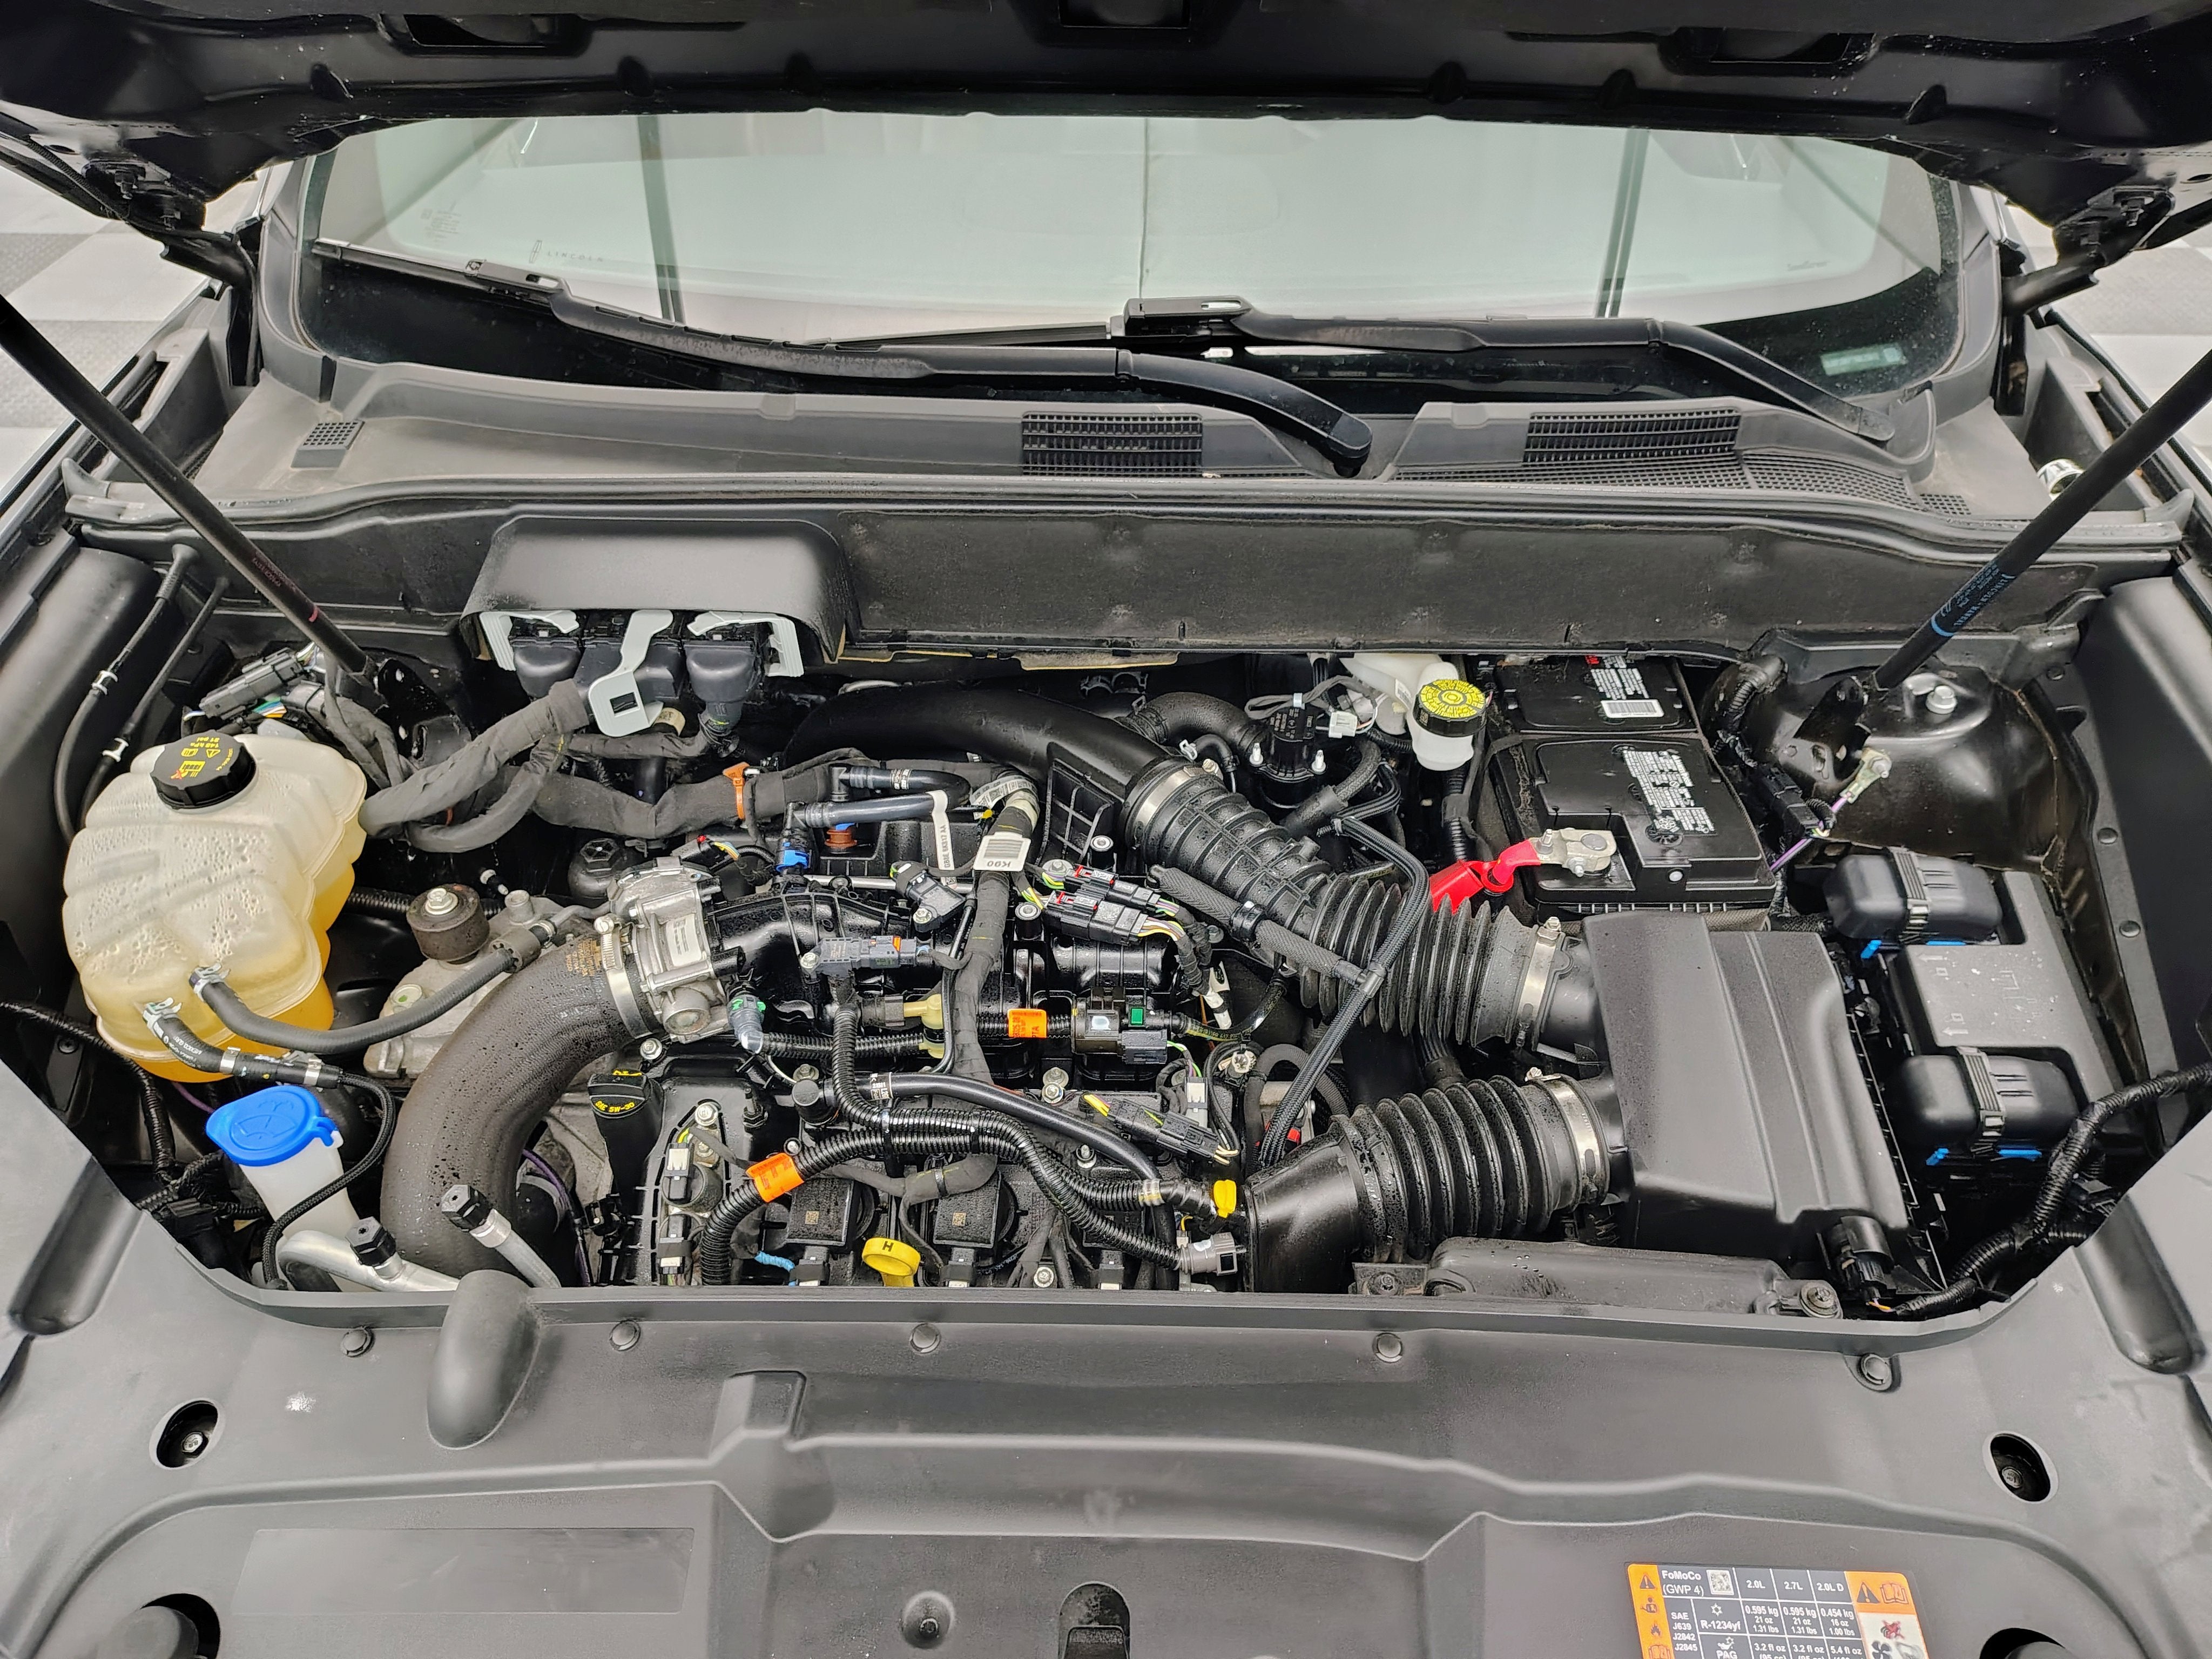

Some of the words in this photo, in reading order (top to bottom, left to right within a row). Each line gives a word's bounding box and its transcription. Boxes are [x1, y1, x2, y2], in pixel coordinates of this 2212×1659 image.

[548, 251, 603, 262] LINCOLN
[595, 1101, 608, 1111] SAE
[609, 1102, 635, 1112] 5W-30
[882, 1240, 894, 1252] H
[1661, 1570, 1701, 1580] FoMoCo
[1746, 1580, 1765, 1589] 2.0L
[1784, 1581, 1803, 1590] 2.7L
[1816, 1582, 1836, 1591] 2.0L
[1836, 1583, 1844, 1591] D
[1663, 1584, 1692, 1595] (GWP
[1694, 1586, 1704, 1597] 4)
[1745, 1605, 1766, 1614] 0.595
[1768, 1606, 1779, 1617] kg
[1783, 1607, 1804, 1616] 0.595
[1806, 1608, 1817, 1618] kg
[1820, 1608, 1842, 1617] 0.454
[1843, 1609, 1854, 1620] kg
[1673, 1622, 1692, 1630] J639
[1701, 1620, 1741, 1632] R-1234yf
[1753, 1624, 1766, 1633] 1.31
[1768, 1625, 1779, 1633] lbs
[1807, 1627, 1817, 1635] lbs
[1673, 1633, 1696, 1641] J2842
[1754, 1643, 1767, 1651] 3.2
[1768, 1643, 1775, 1651] fl
[1792, 1644, 1805, 1653] 3.2
[1806, 1644, 1813, 1653] fl
[1830, 1645, 1843, 1654] 5.4
[1716, 1650, 1738, 1659] PAG
